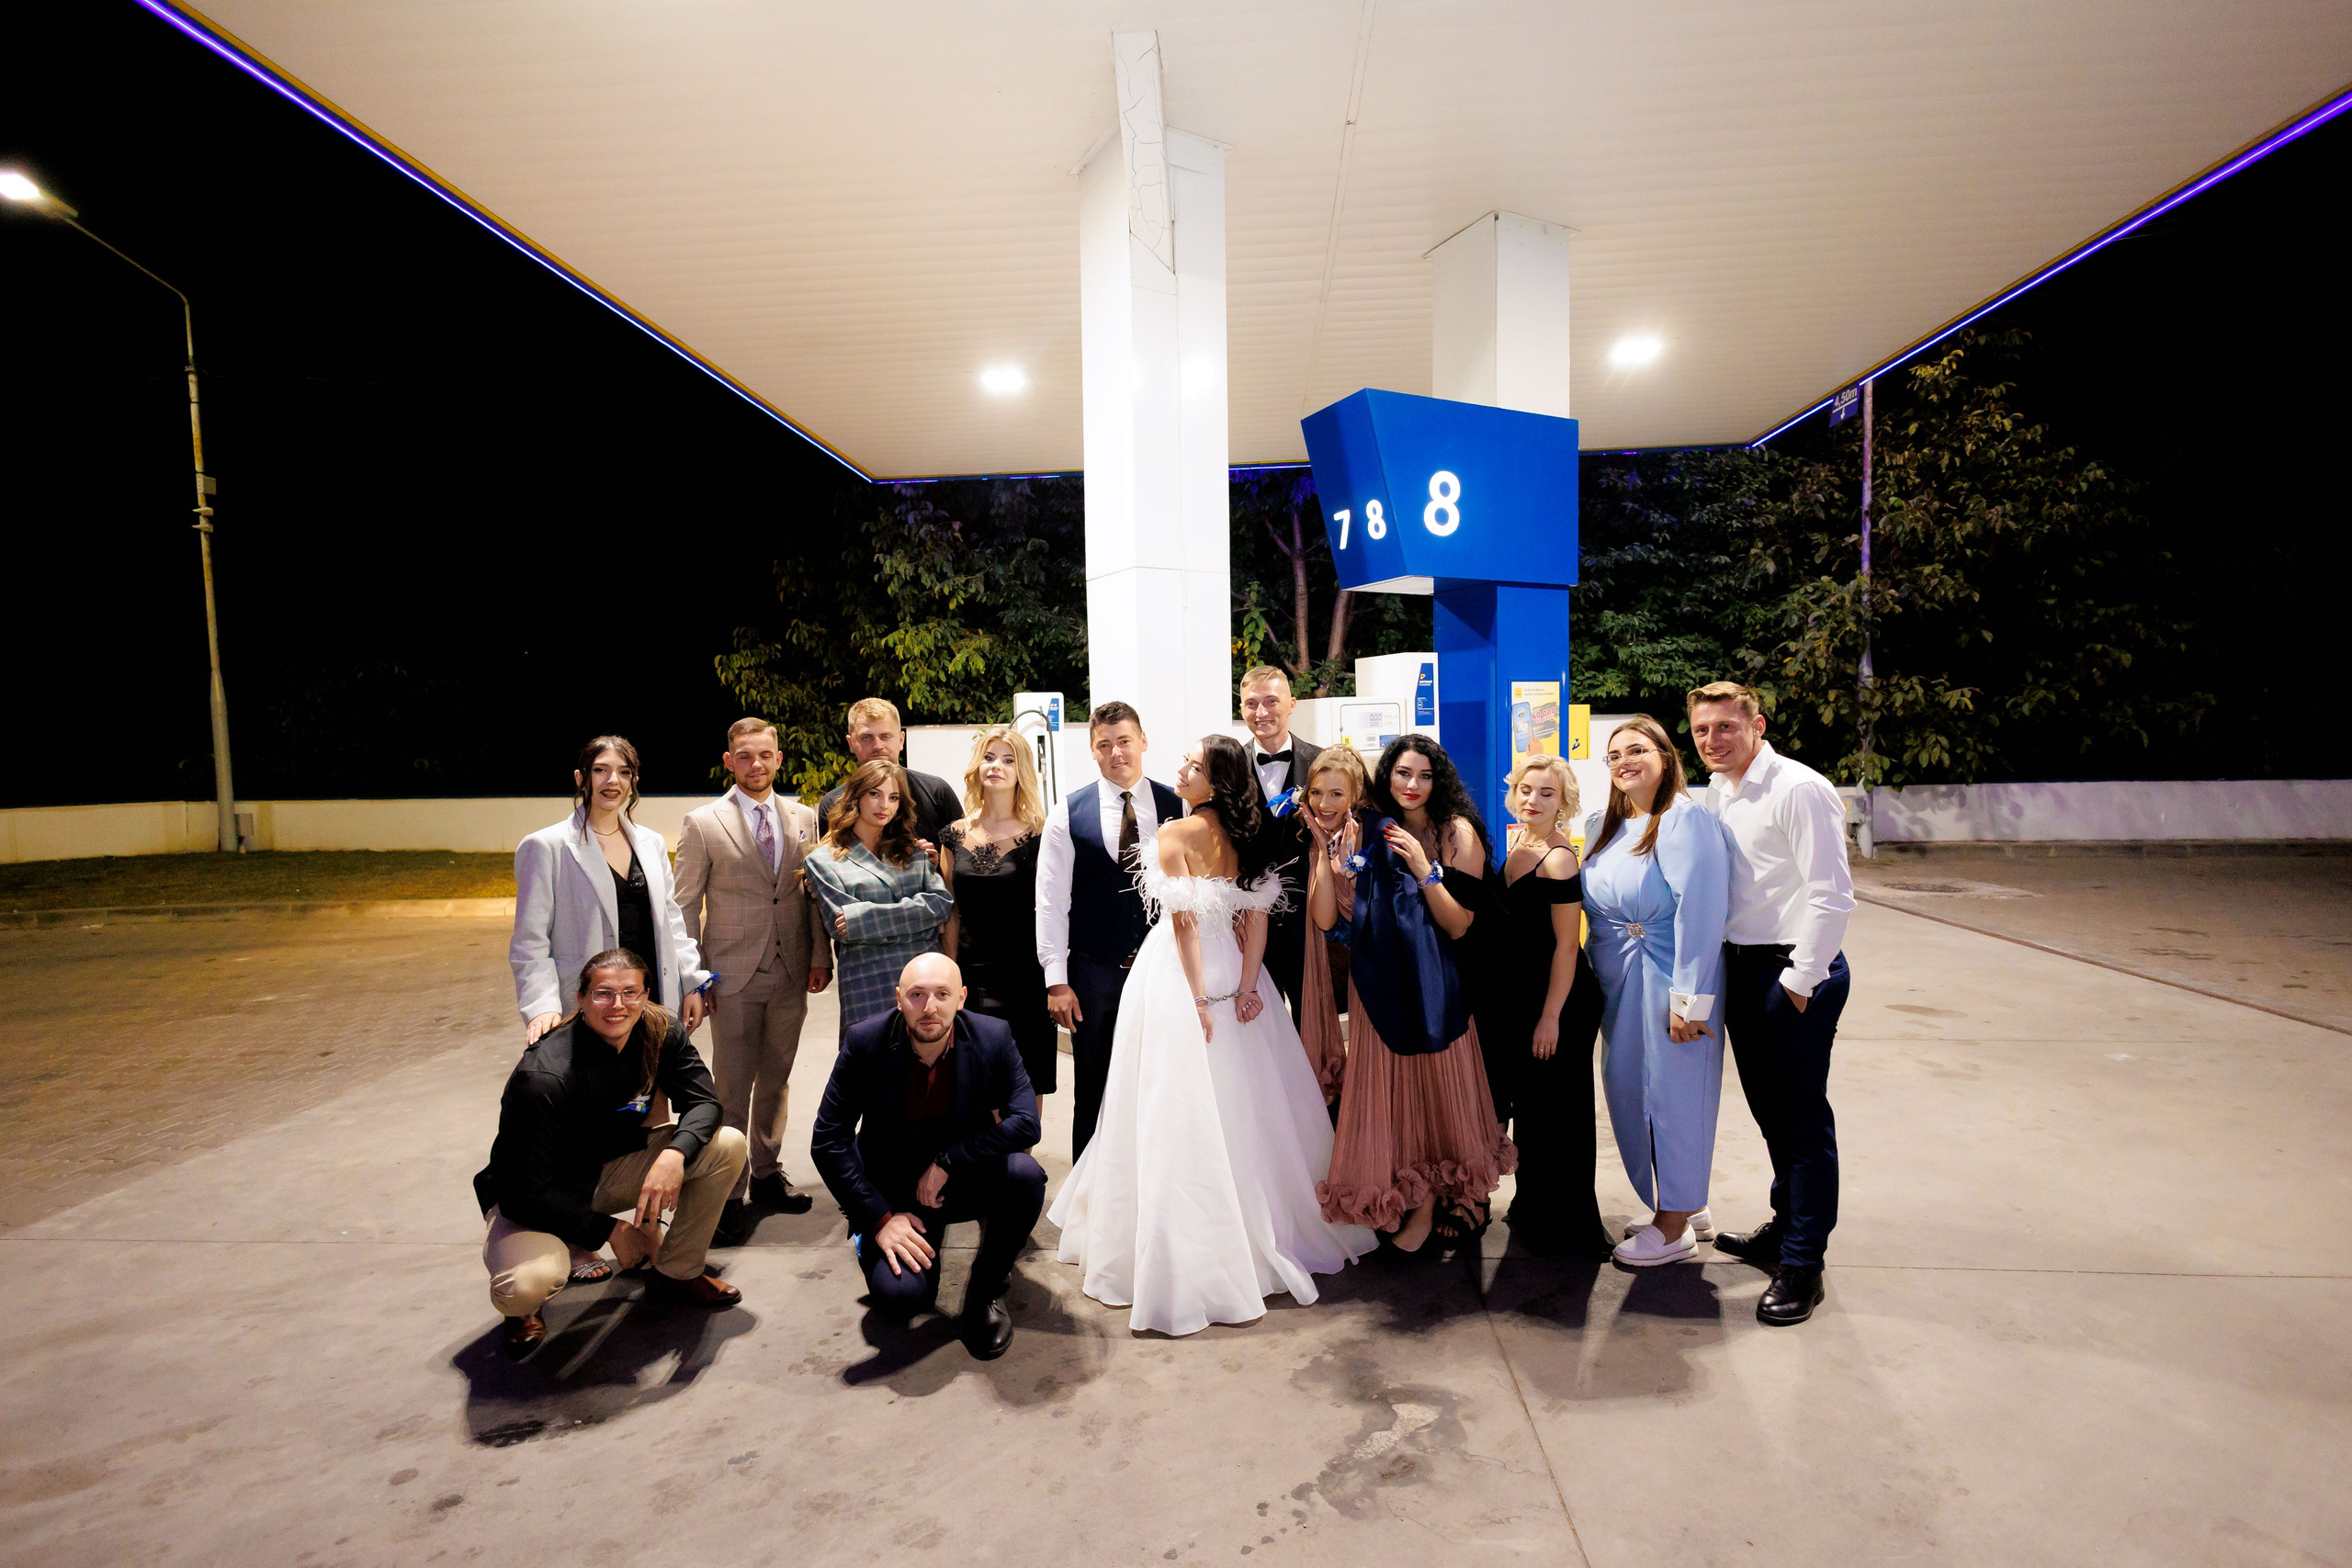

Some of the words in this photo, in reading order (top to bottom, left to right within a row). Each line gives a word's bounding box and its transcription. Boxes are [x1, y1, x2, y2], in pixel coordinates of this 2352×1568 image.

[1834, 388, 1858, 407] 4,50m
[1423, 469, 1462, 537] 8
[1333, 509, 1351, 550] 7
[1365, 499, 1387, 540] 8
[1532, 711, 1541, 719] 60
[1543, 707, 1556, 716] 000
